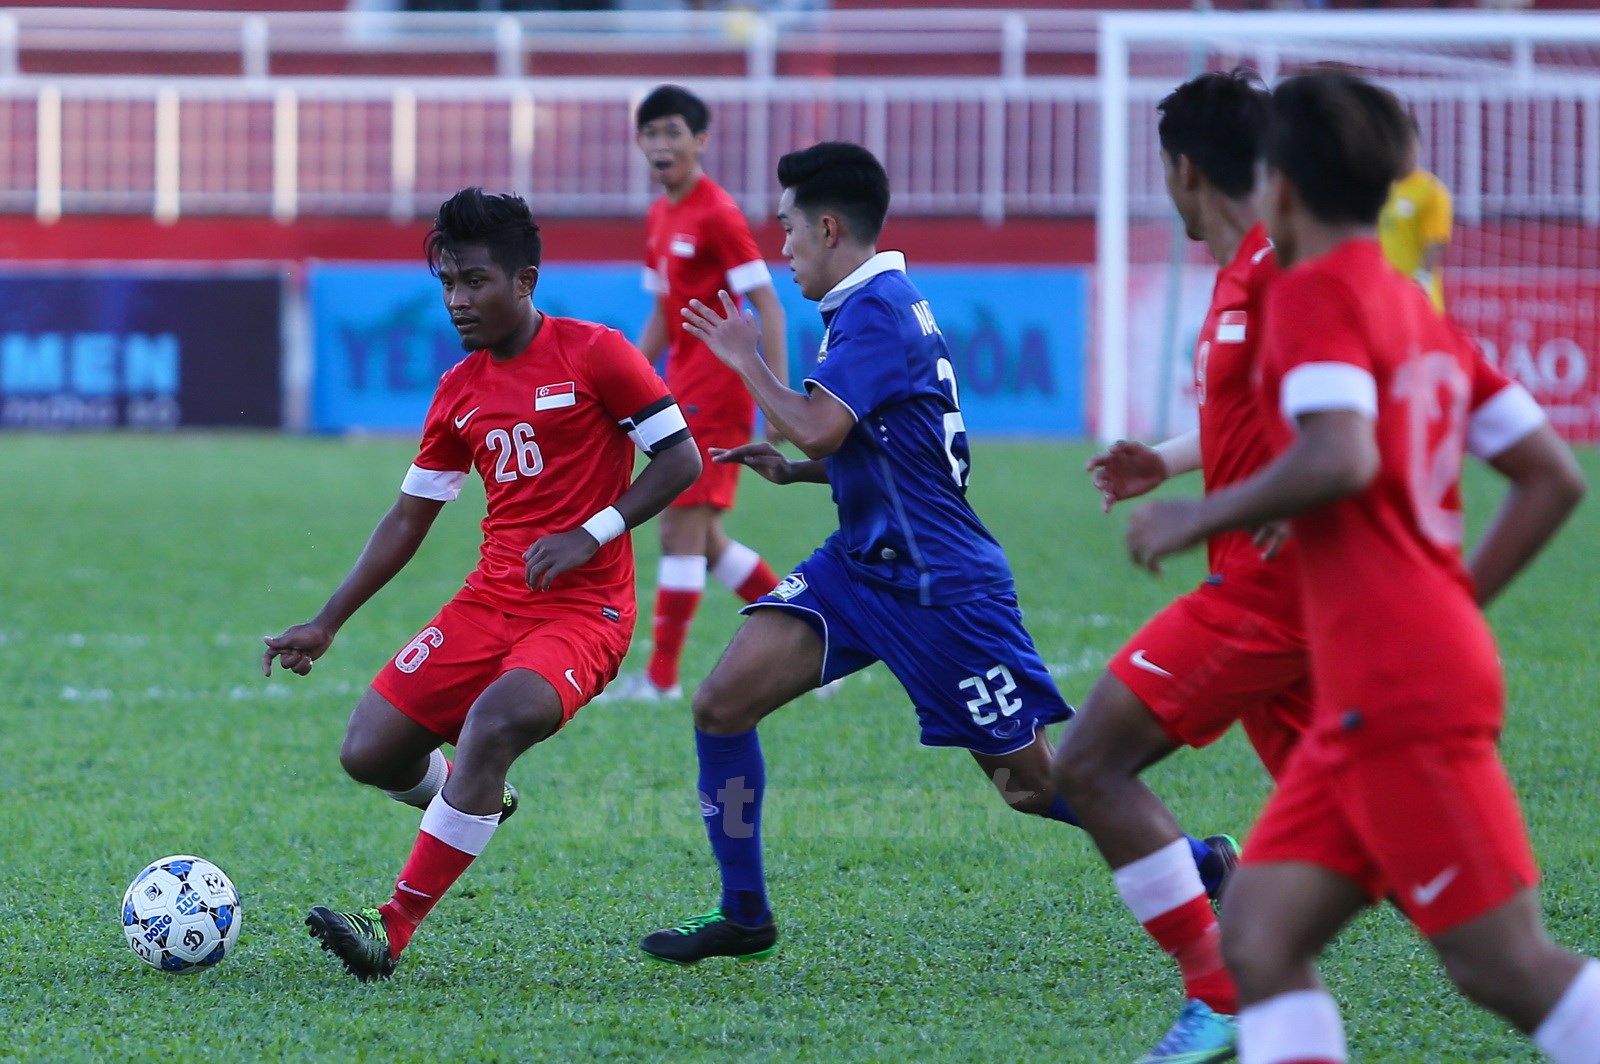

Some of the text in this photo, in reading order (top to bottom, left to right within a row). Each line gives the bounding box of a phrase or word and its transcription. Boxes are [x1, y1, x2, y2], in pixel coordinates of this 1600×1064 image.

[485, 422, 544, 484] 26
[394, 626, 444, 674] 6
[958, 664, 1022, 726] 22
[144, 892, 201, 943] DONG LUC
